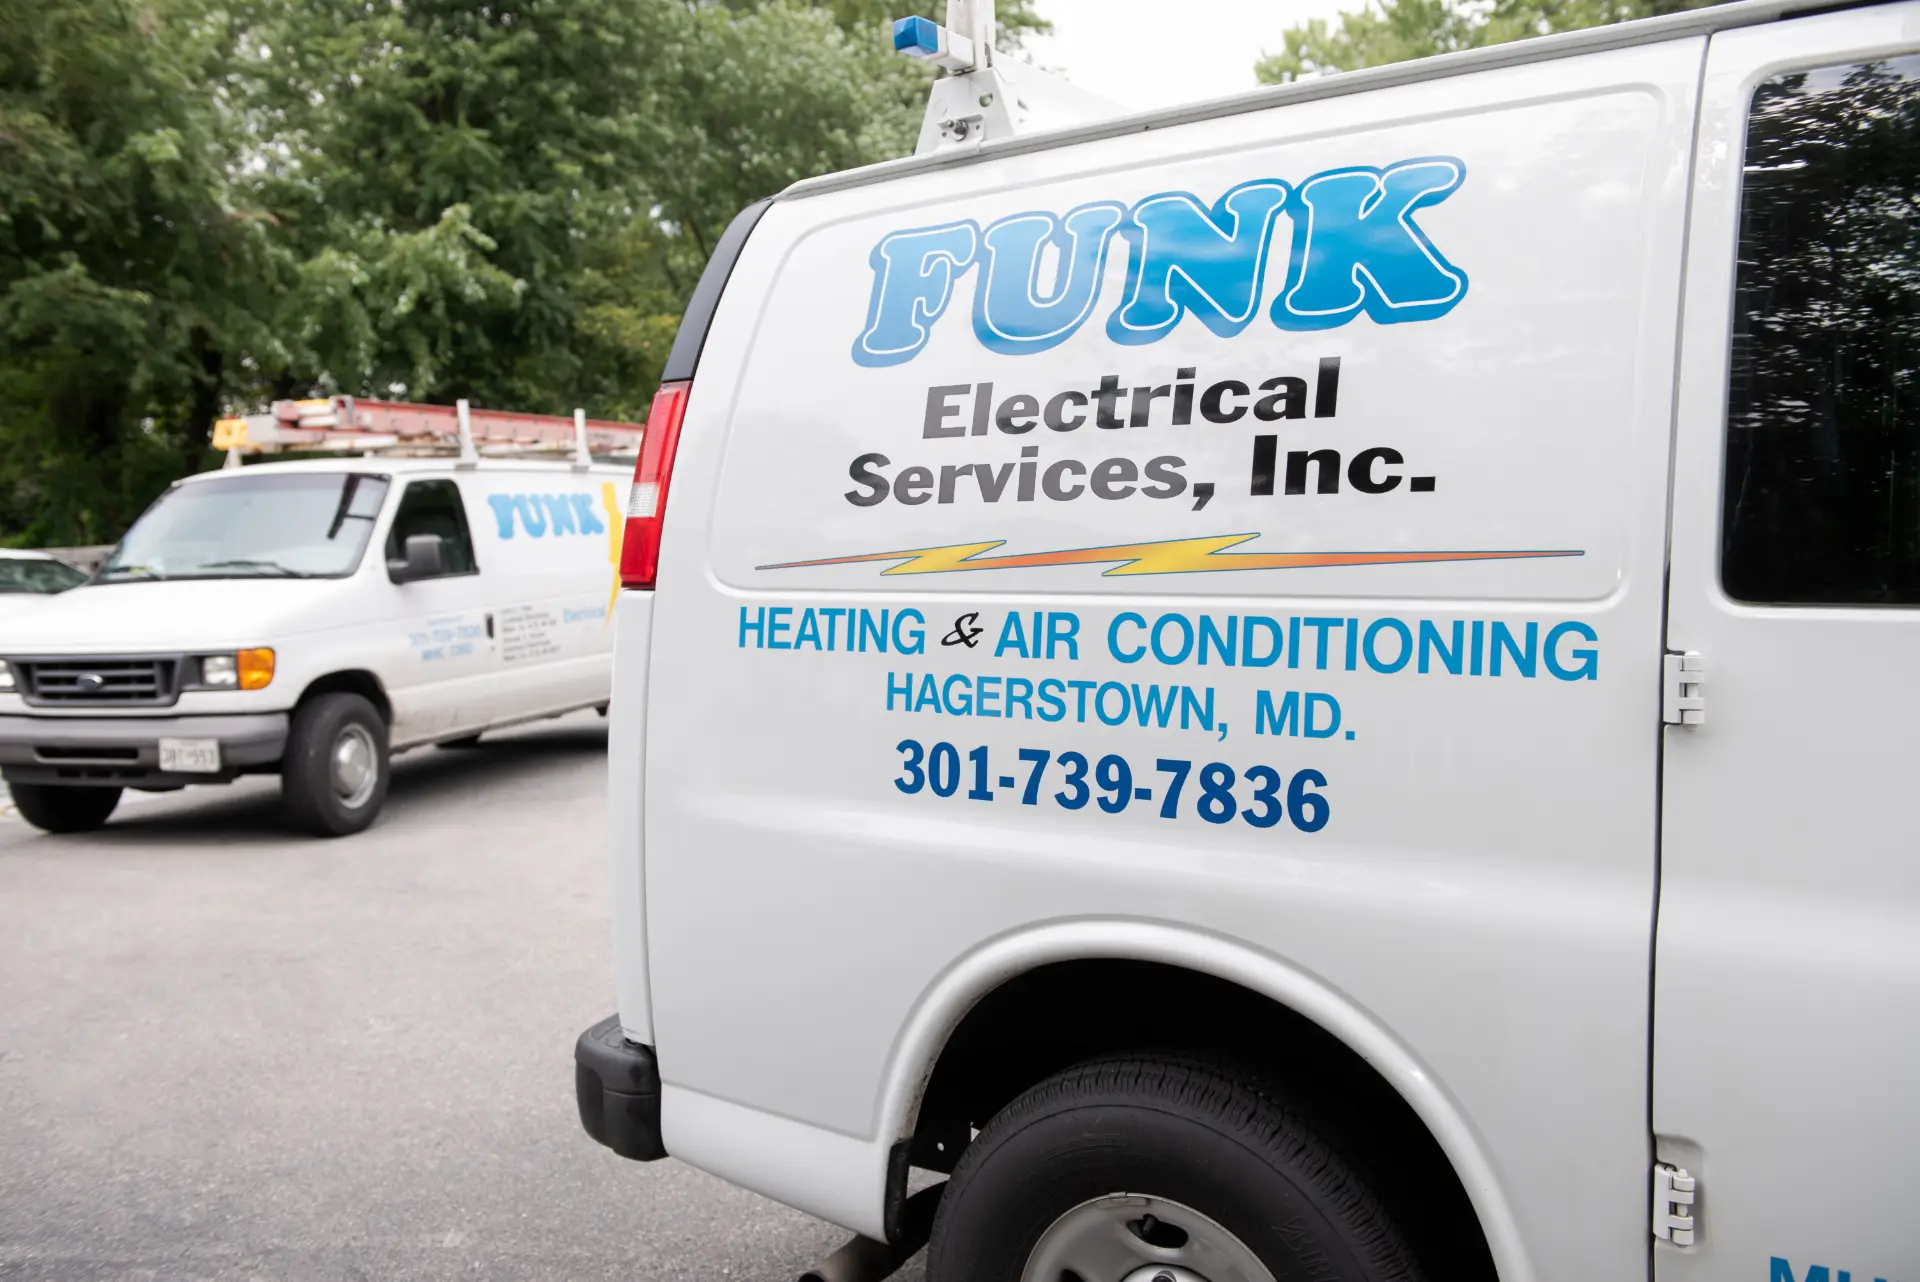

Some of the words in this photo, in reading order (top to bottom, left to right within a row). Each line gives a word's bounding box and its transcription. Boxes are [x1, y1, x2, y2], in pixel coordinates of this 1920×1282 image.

[852, 156, 1469, 367] FUNK
[922, 356, 1341, 440] Electrical
[843, 445, 1215, 511] Services,
[1250, 434, 1436, 496] Inc.
[739, 606, 926, 655] HEATING
[941, 611, 984, 649] &
[995, 610, 1080, 660] AIR
[1108, 611, 1599, 681] CONDITIONING
[887, 672, 1228, 742] HAGERSTOWN,
[1256, 690, 1356, 741] MD.
[895, 739, 1330, 833] 301-739-7836
